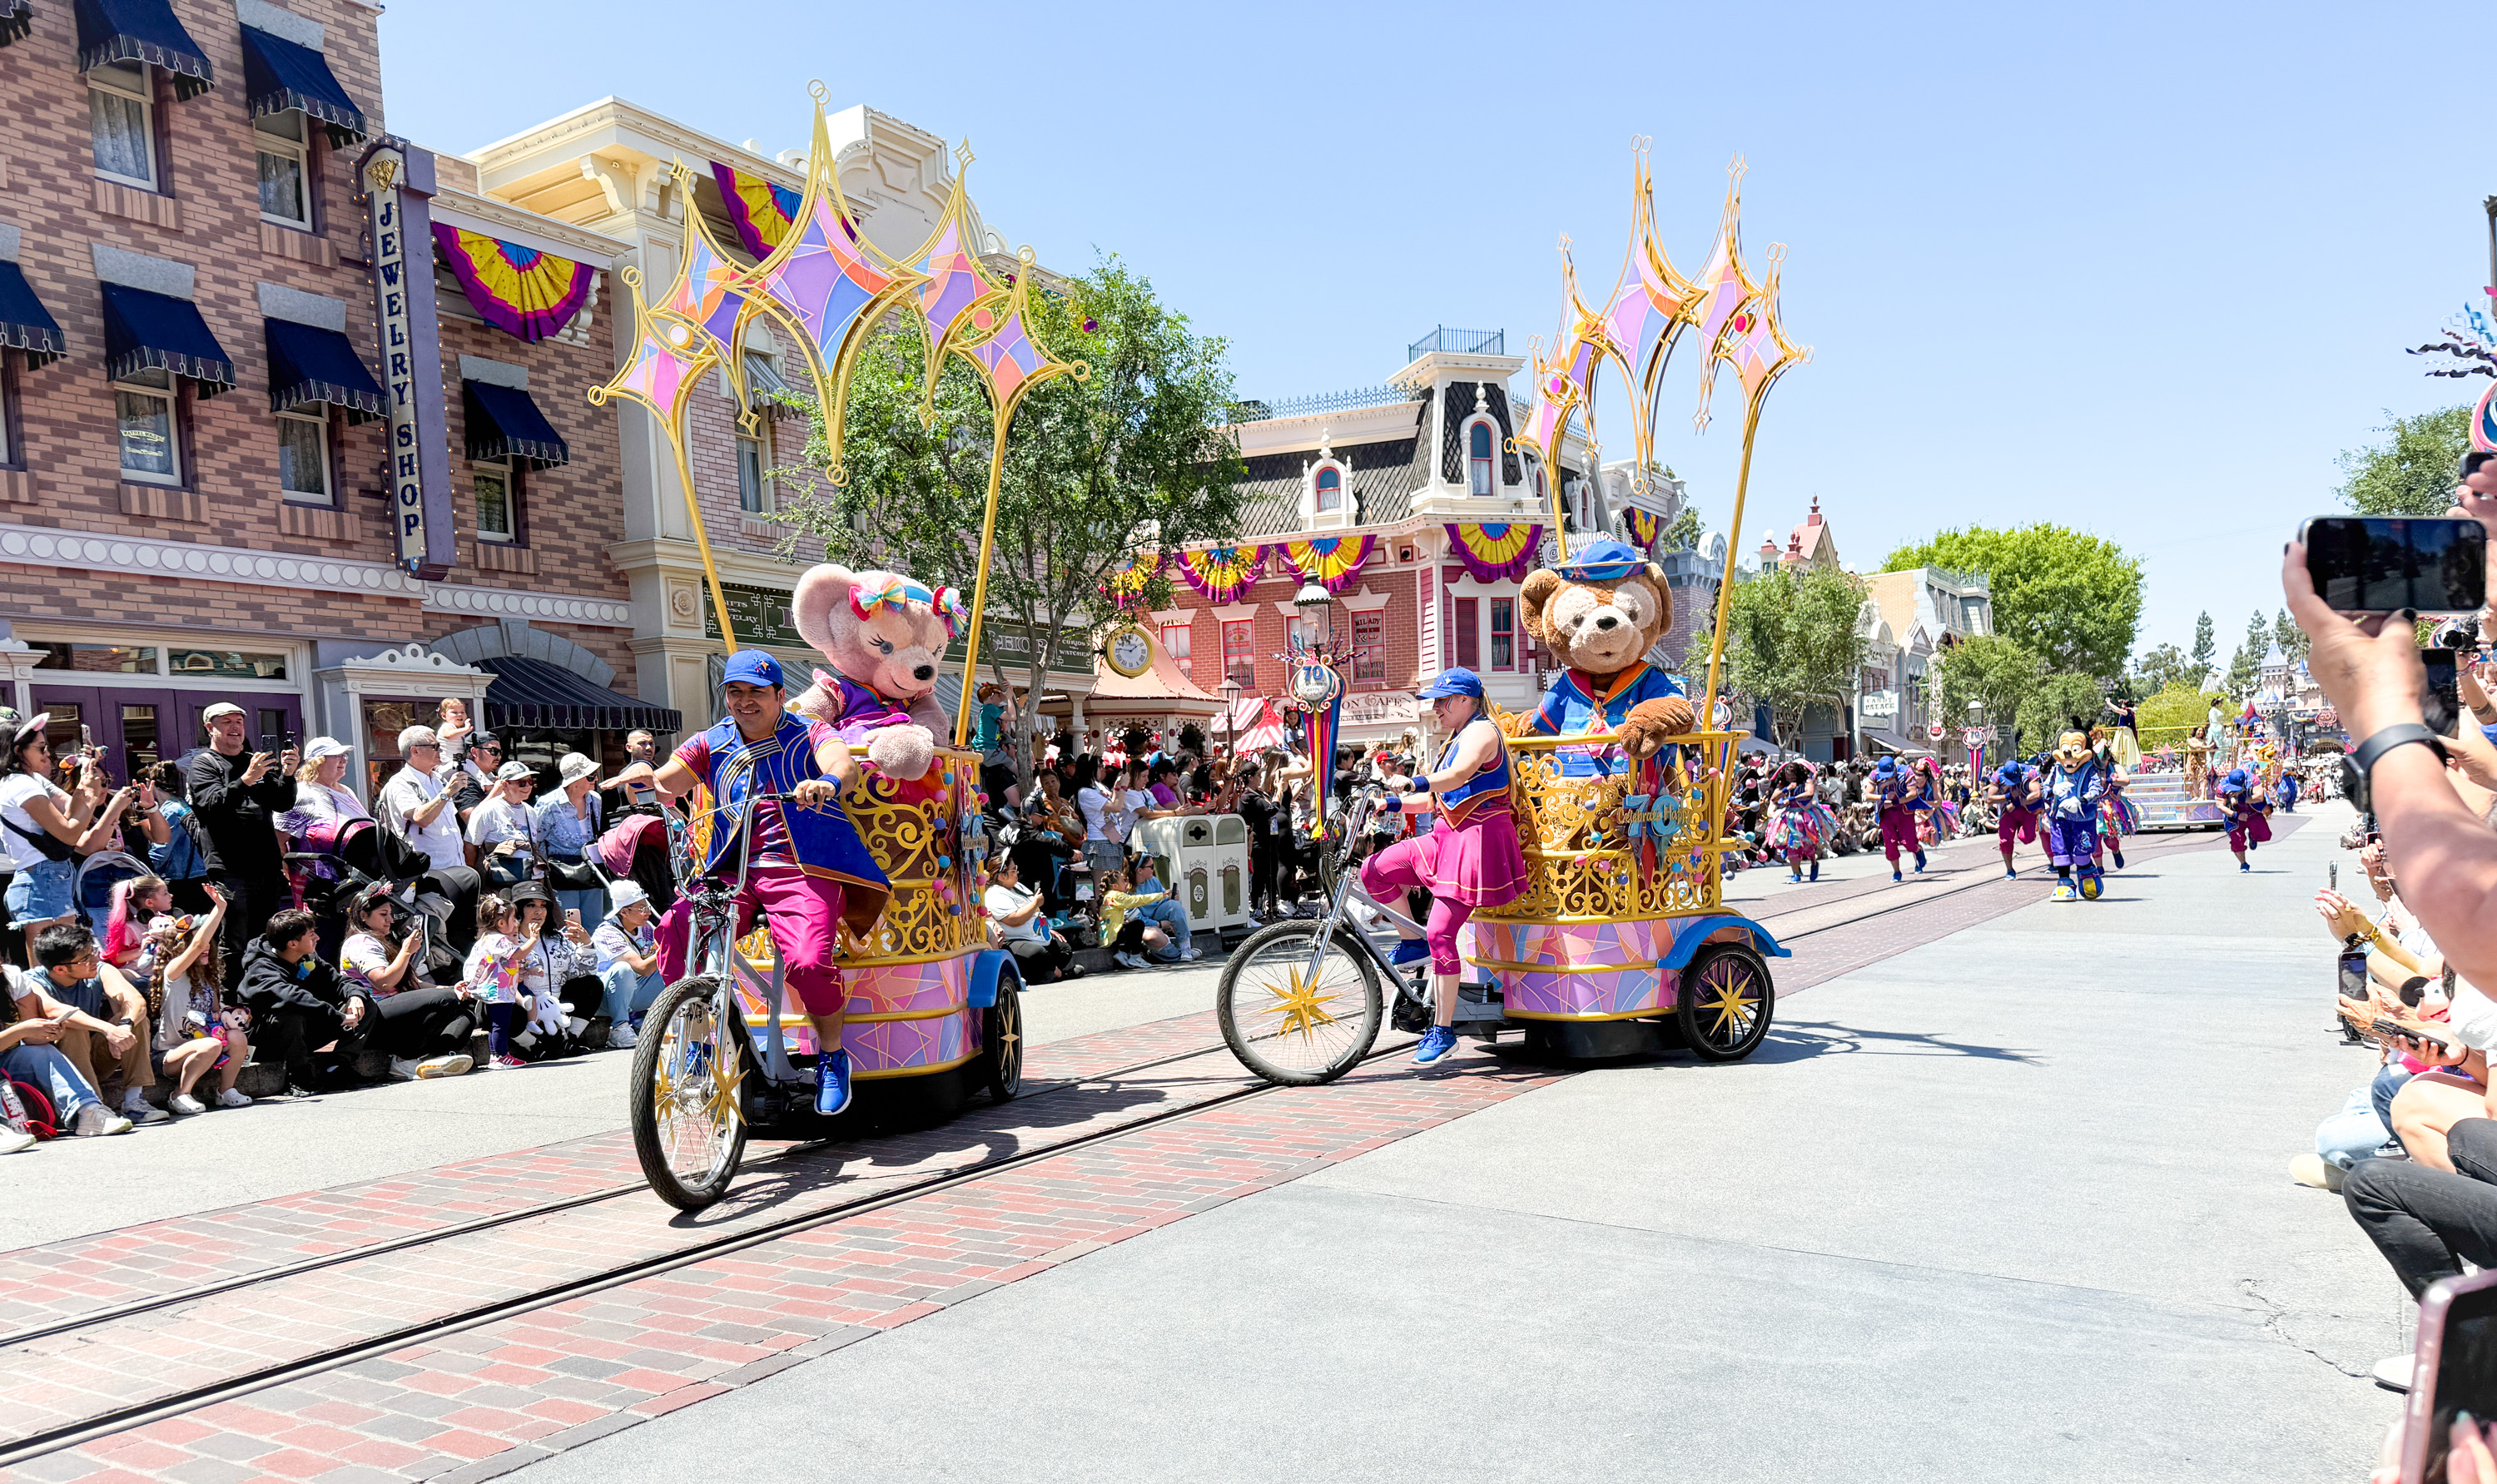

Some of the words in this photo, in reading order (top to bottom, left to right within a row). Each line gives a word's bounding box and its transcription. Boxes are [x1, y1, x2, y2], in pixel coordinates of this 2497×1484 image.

[380, 201, 408, 405] JEWELRY
[396, 424, 419, 536] SHOP
[725, 599, 748, 608] IFTS
[709, 612, 758, 623] JELRY
[1303, 665, 1323, 681] 70
[1865, 702, 1895, 711] PALACE
[1616, 807, 1661, 825] Celebrate
[1662, 802, 1691, 826] Happy
[1622, 793, 1680, 837] 70
